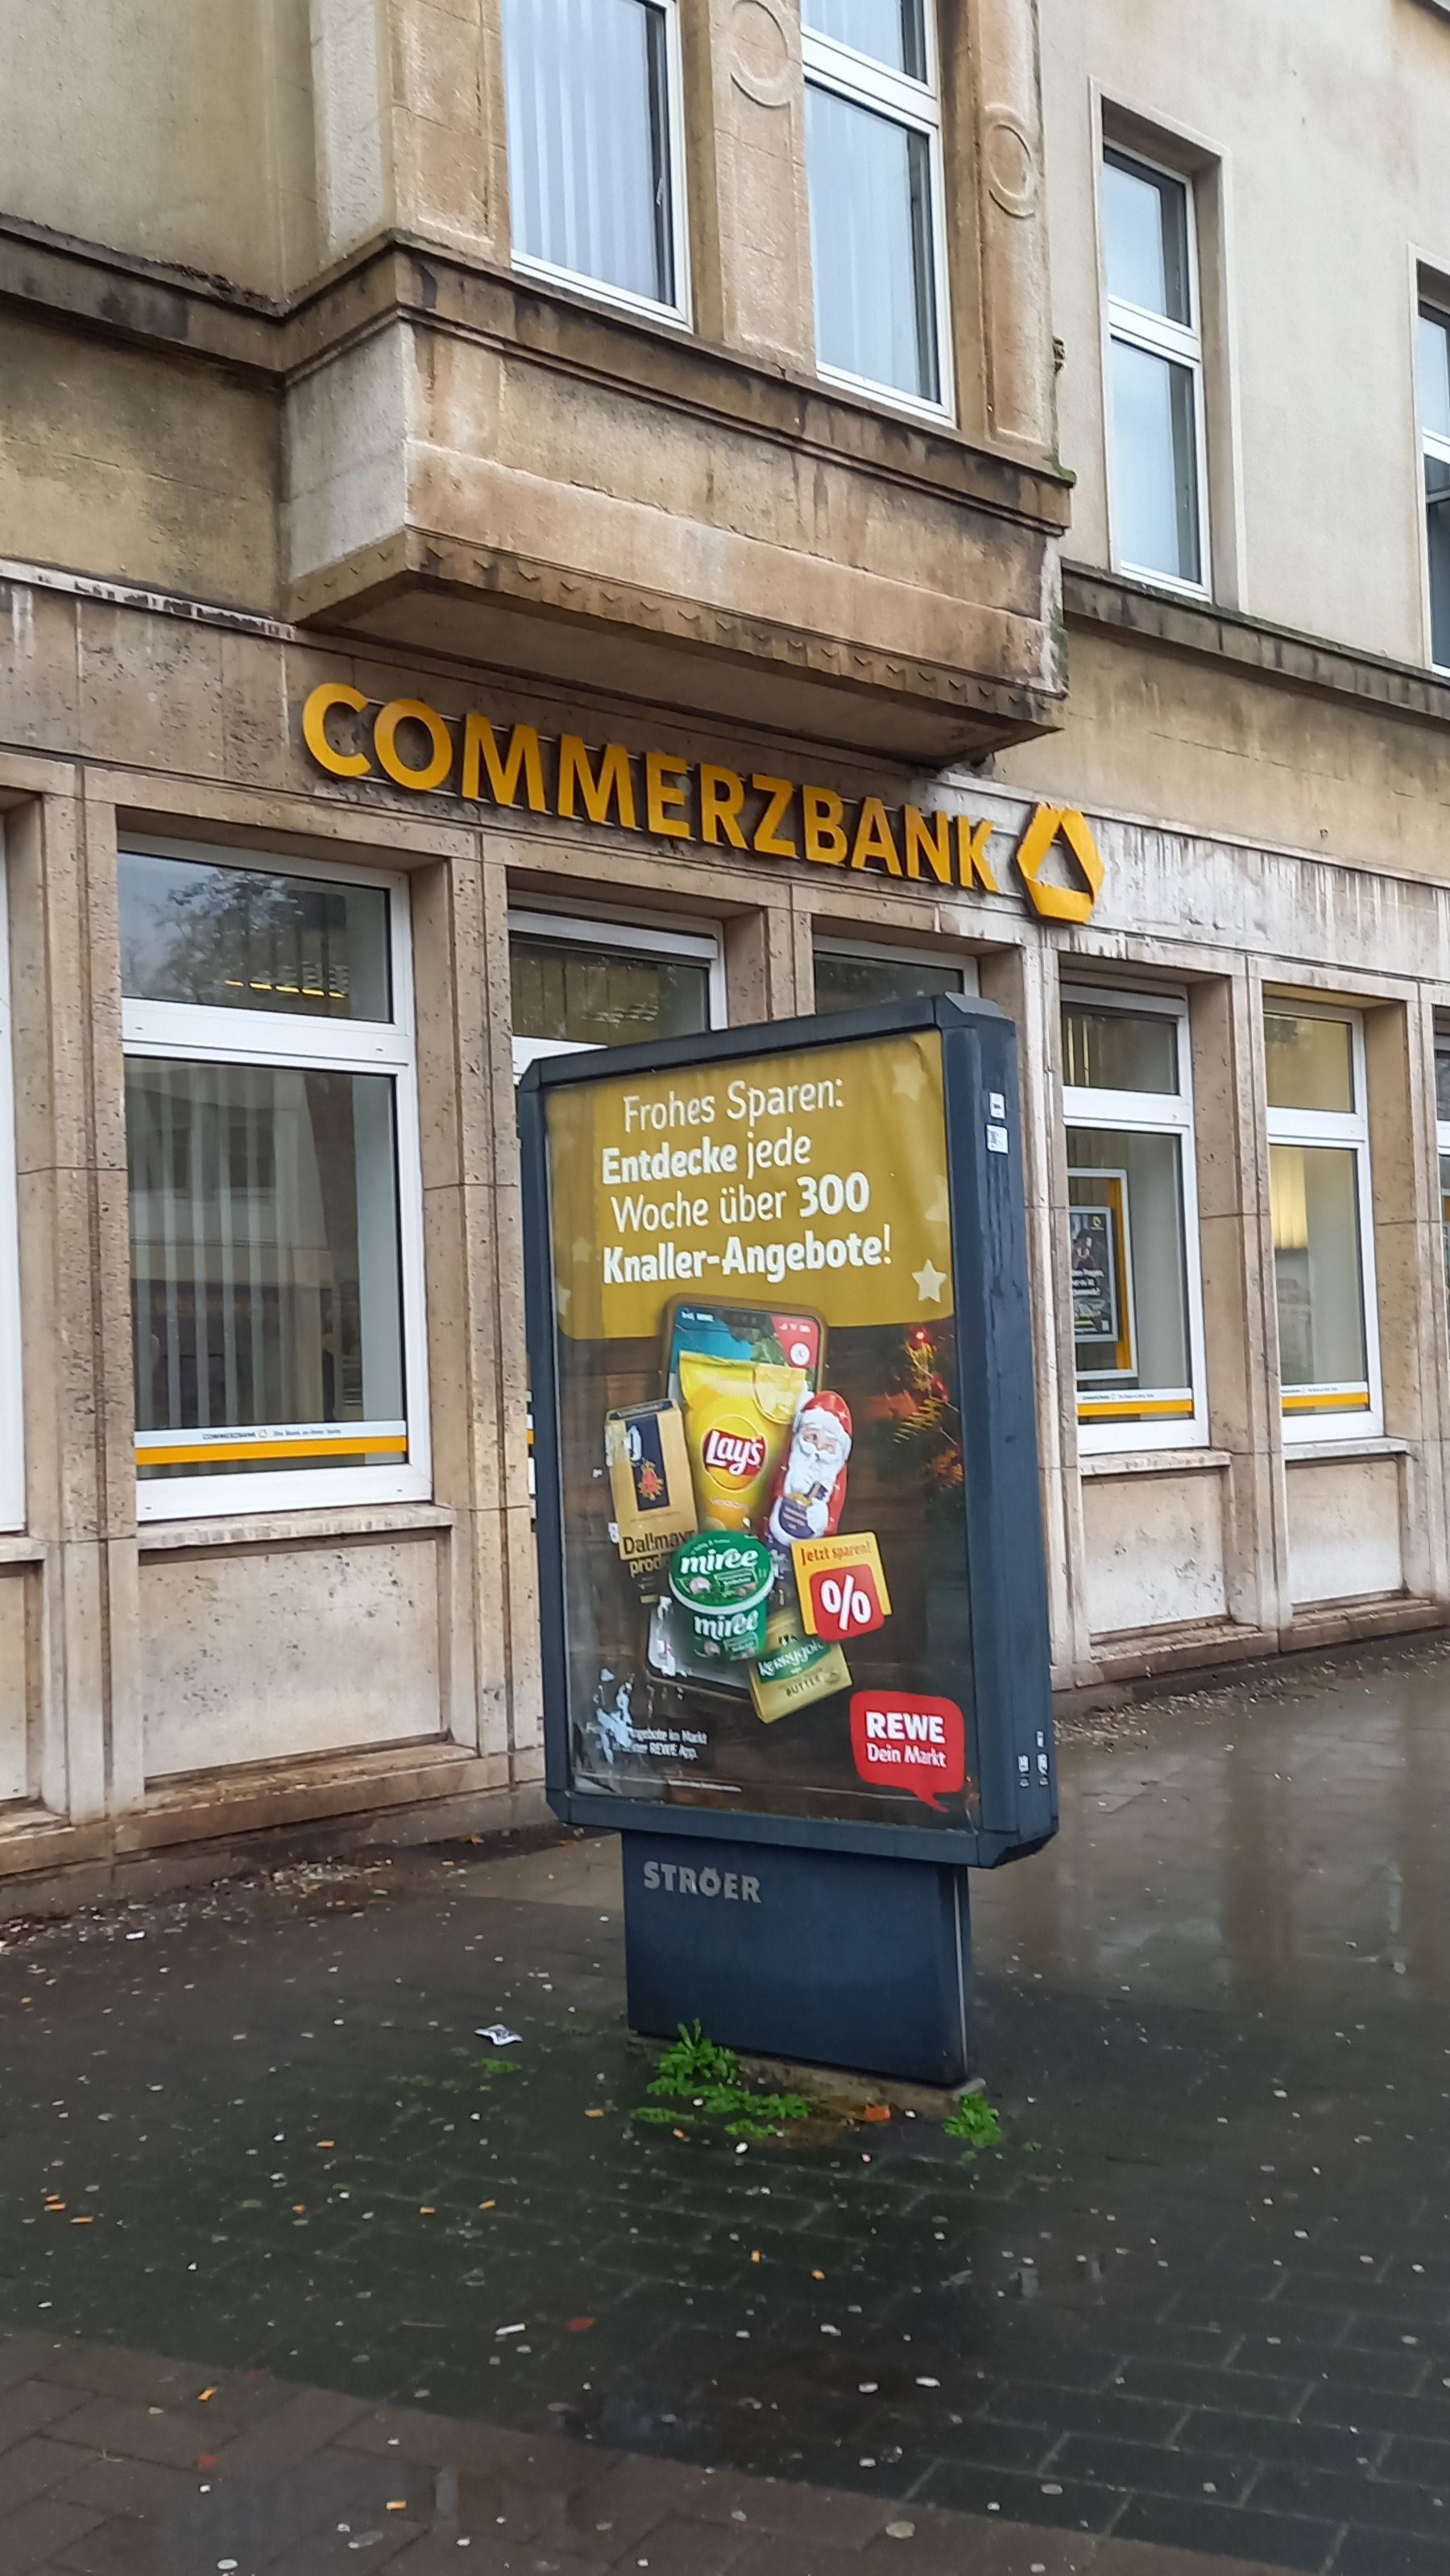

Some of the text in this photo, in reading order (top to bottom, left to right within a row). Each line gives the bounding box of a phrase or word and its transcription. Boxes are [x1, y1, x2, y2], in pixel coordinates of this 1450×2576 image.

[302, 682, 999, 893] COMMERZBANK
[624, 1078, 844, 1133] Frohes Sparen:
[602, 1127, 811, 1185] Entdecke jede
[611, 1171, 870, 1233] Woche über 300
[603, 1224, 892, 1284] Knaller-Angebote!
[705, 1431, 764, 1476] Lay's
[629, 1554, 665, 1578] prod
[681, 1547, 759, 1575] miree
[800, 1540, 871, 1566] Jetzt sparen!
[820, 1574, 872, 1631] %
[693, 1609, 759, 1641] miree
[866, 1711, 946, 1744] REWE
[866, 1742, 947, 1768] Dein Markt
[643, 1860, 762, 1904] STRÖER
